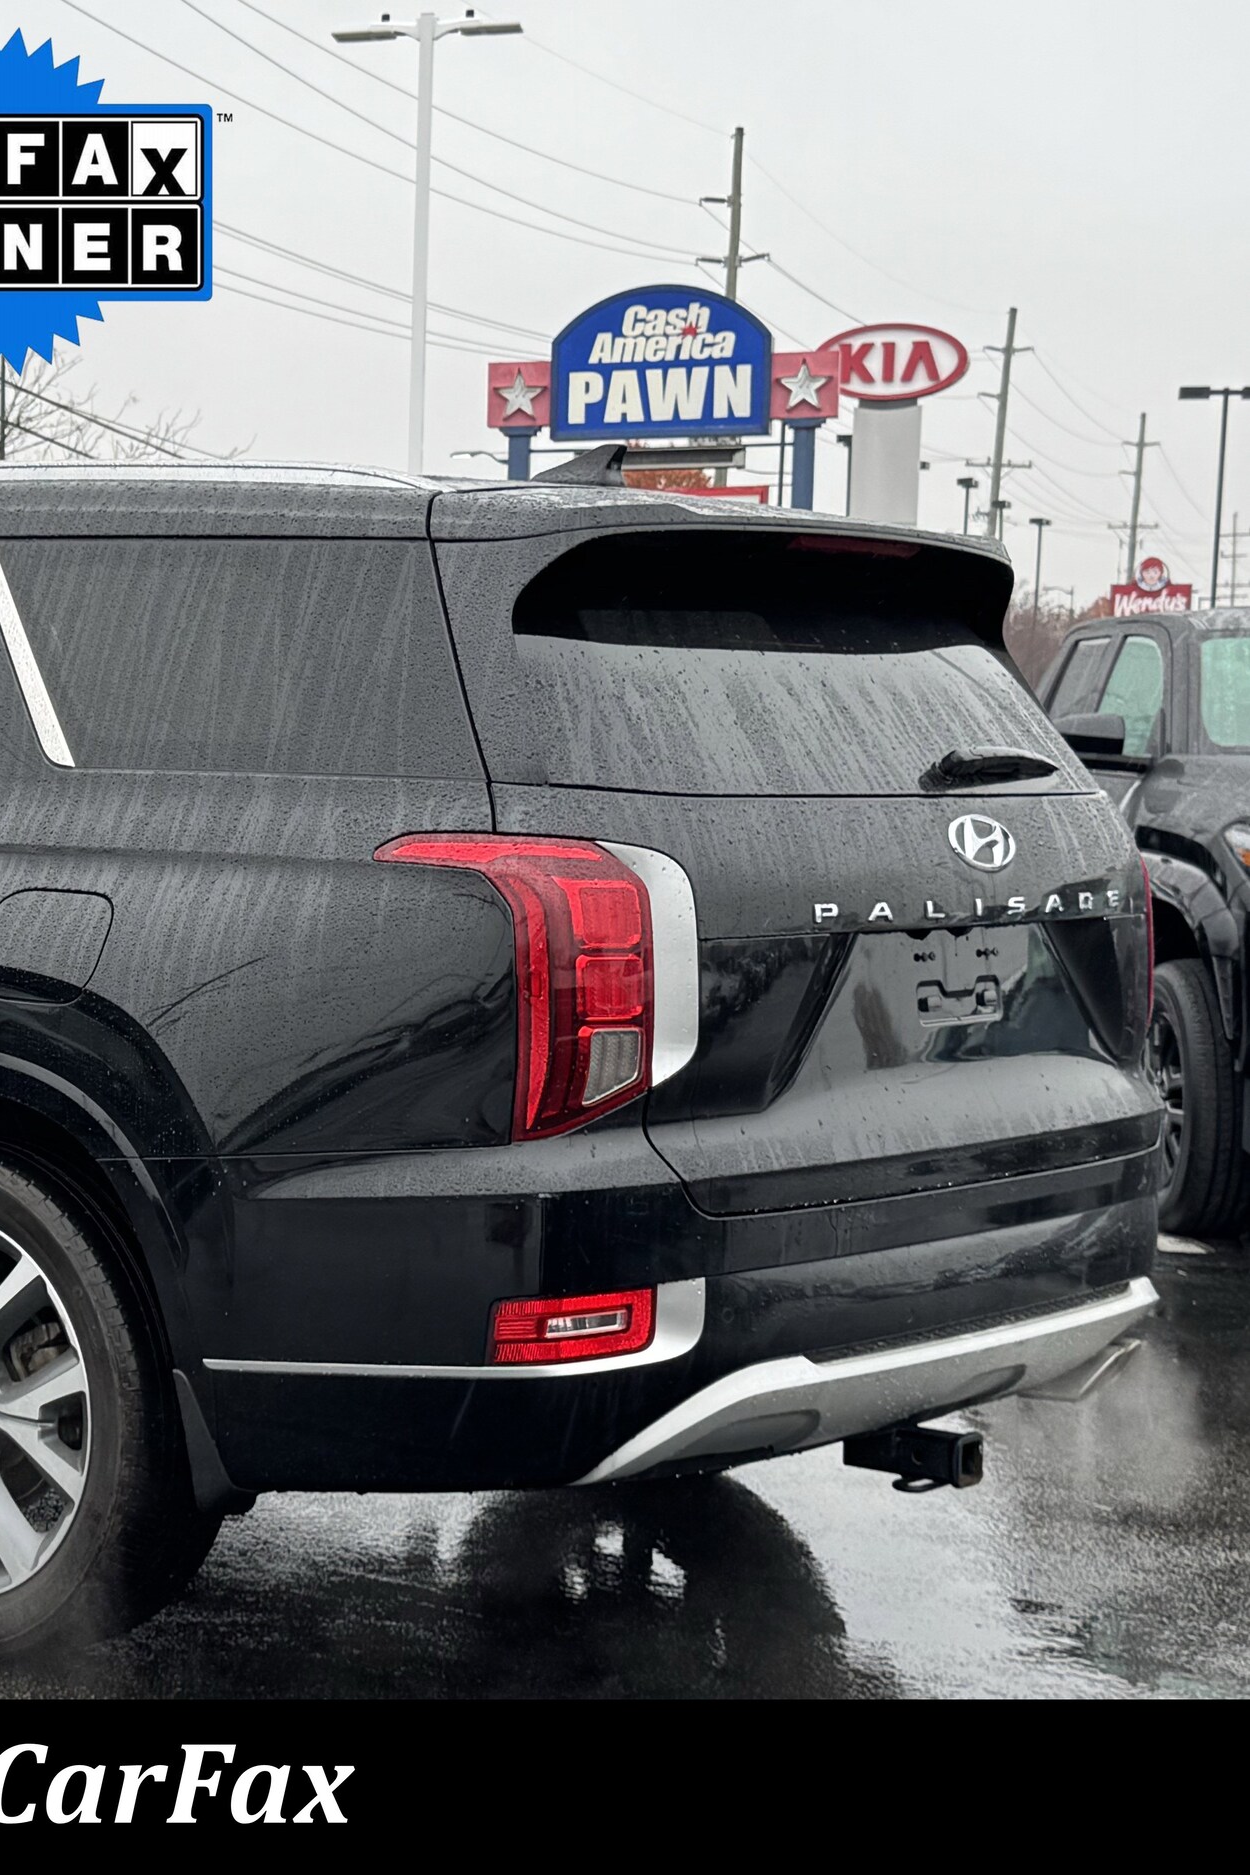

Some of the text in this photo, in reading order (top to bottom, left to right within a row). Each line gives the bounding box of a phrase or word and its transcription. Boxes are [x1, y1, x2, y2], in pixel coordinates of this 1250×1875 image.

[621, 301, 711, 337] Cash
[587, 330, 737, 365] America
[839, 340, 941, 385] KIA
[567, 363, 753, 425] PAWN
[1113, 588, 1188, 618] Wendy's
[813, 889, 1121, 923] PALISADE
